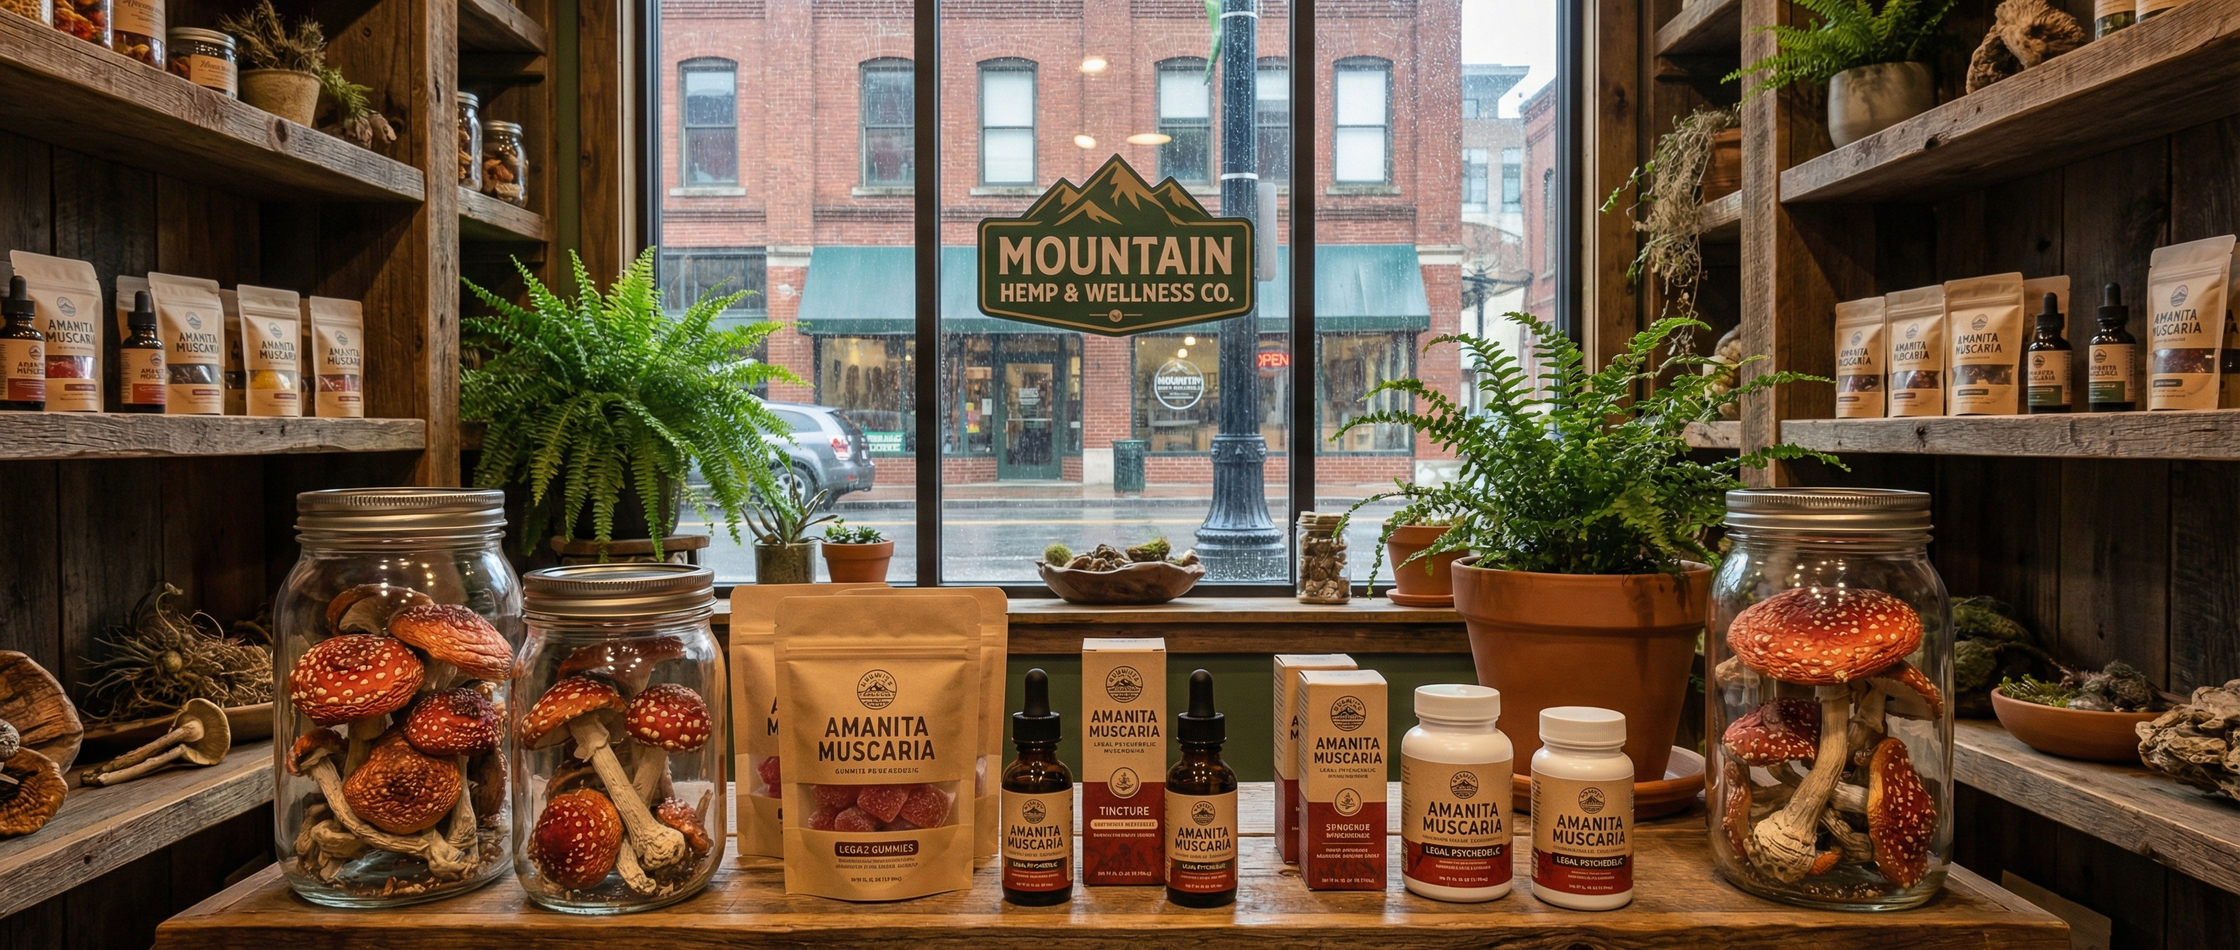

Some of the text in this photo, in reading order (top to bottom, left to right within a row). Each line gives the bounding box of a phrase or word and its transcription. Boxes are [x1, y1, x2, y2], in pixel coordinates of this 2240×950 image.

[998, 235, 1233, 276] MOUNTAIN
[1000, 283, 1235, 302] HEMP & WELLNESS CO.
[2154, 308, 2198, 324] AMANITA
[48, 319, 94, 333] AMANITA
[179, 332, 217, 344] AMANITA
[1957, 333, 1999, 345] AMANITA
[1091, 709, 1158, 723] AMANITA
[825, 716, 929, 737] AMANITA
[1089, 725, 1160, 738] MUSCARIA
[1315, 737, 1380, 750] AMANITA
[818, 740, 936, 762] MUSCARIA
[1314, 752, 1383, 764] MUSCARIA
[1099, 806, 1150, 816] TINCTURE
[1427, 801, 1499, 818] AMANITA
[1423, 817, 1503, 835] MUSCARIA
[1557, 814, 1623, 831] AMANITA
[1010, 825, 1061, 837] AMANITA
[1177, 826, 1229, 839] AMANITA
[1553, 828, 1625, 846] MUSCARIA
[871, 843, 914, 854] GUMMIES
[1007, 837, 1064, 850] MUSCARIA
[1174, 839, 1232, 852] MUSCARIA
[1556, 856, 1579, 866] LEGAL
